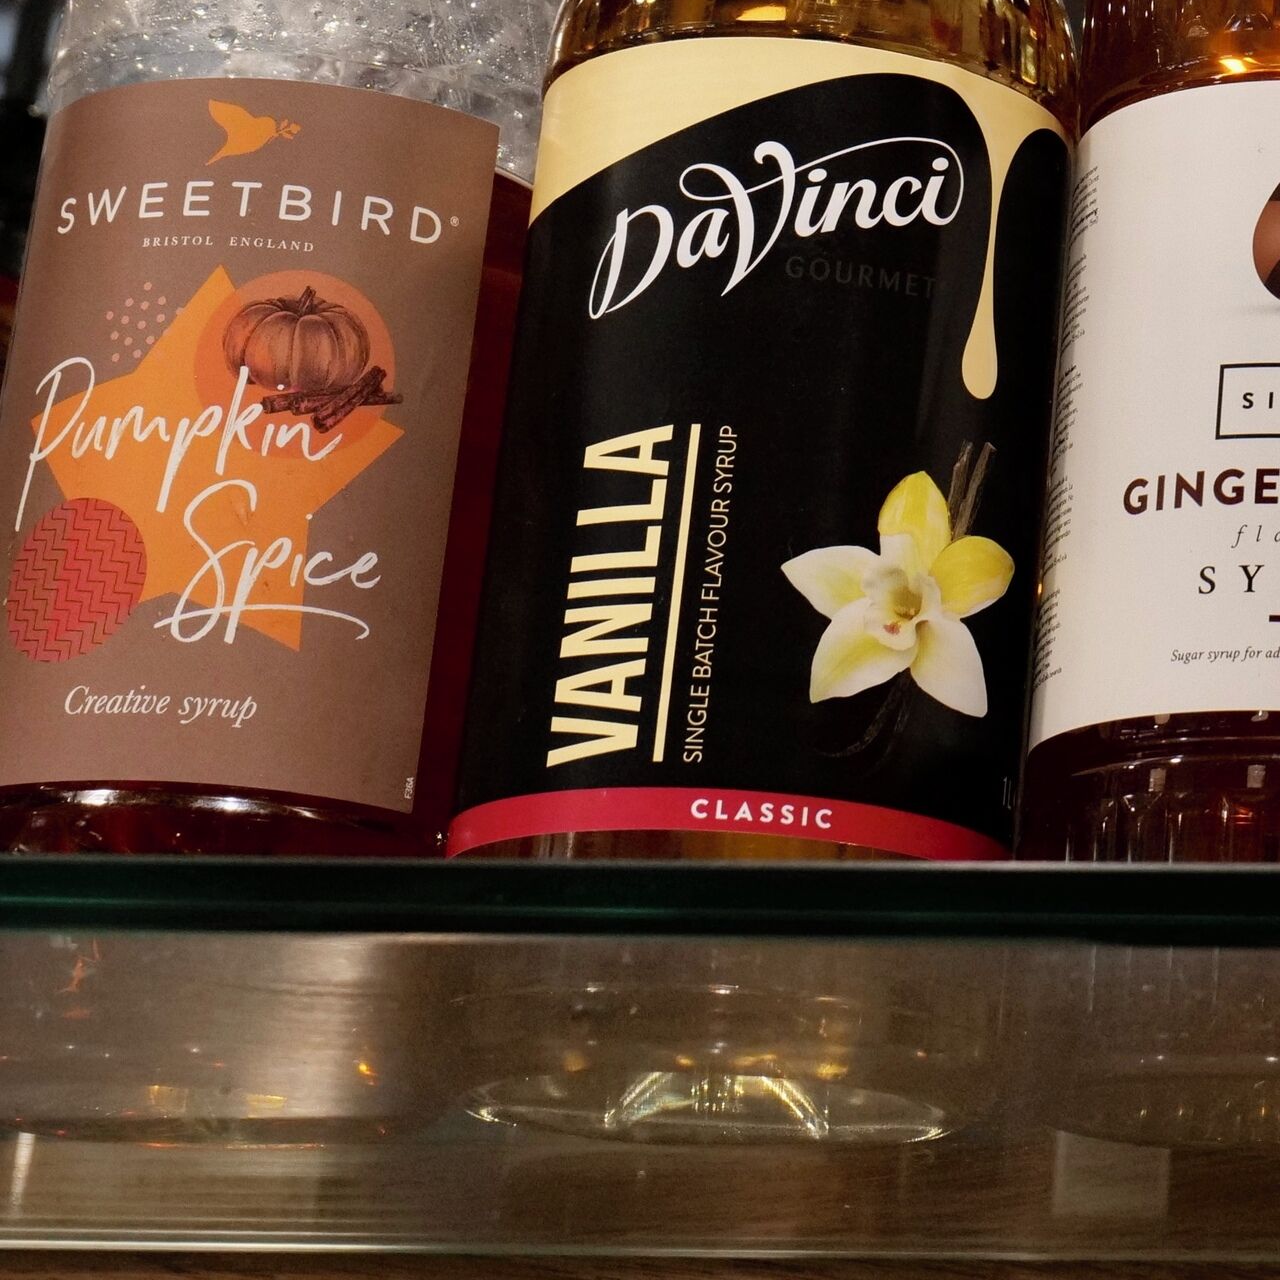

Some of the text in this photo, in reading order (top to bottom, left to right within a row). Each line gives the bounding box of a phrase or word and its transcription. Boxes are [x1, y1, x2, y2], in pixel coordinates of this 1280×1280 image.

[142, 235, 314, 253] BRISTOL ENGLAND
[588, 136, 965, 321] DaVinci
[784, 254, 938, 300] GOURMET
[14, 356, 343, 533] Pumpkin
[152, 478, 382, 645] Spice
[544, 423, 675, 769] VANILLA
[683, 424, 738, 763] SINGLE BATCH FLAVOUR SYRUP
[64, 684, 258, 729] Creative syrup
[1170, 648, 1204, 665] Sugar
[1207, 649, 1241, 664] syrup
[1241, 646, 1263, 663] for
[689, 797, 834, 831] CLASSIC
